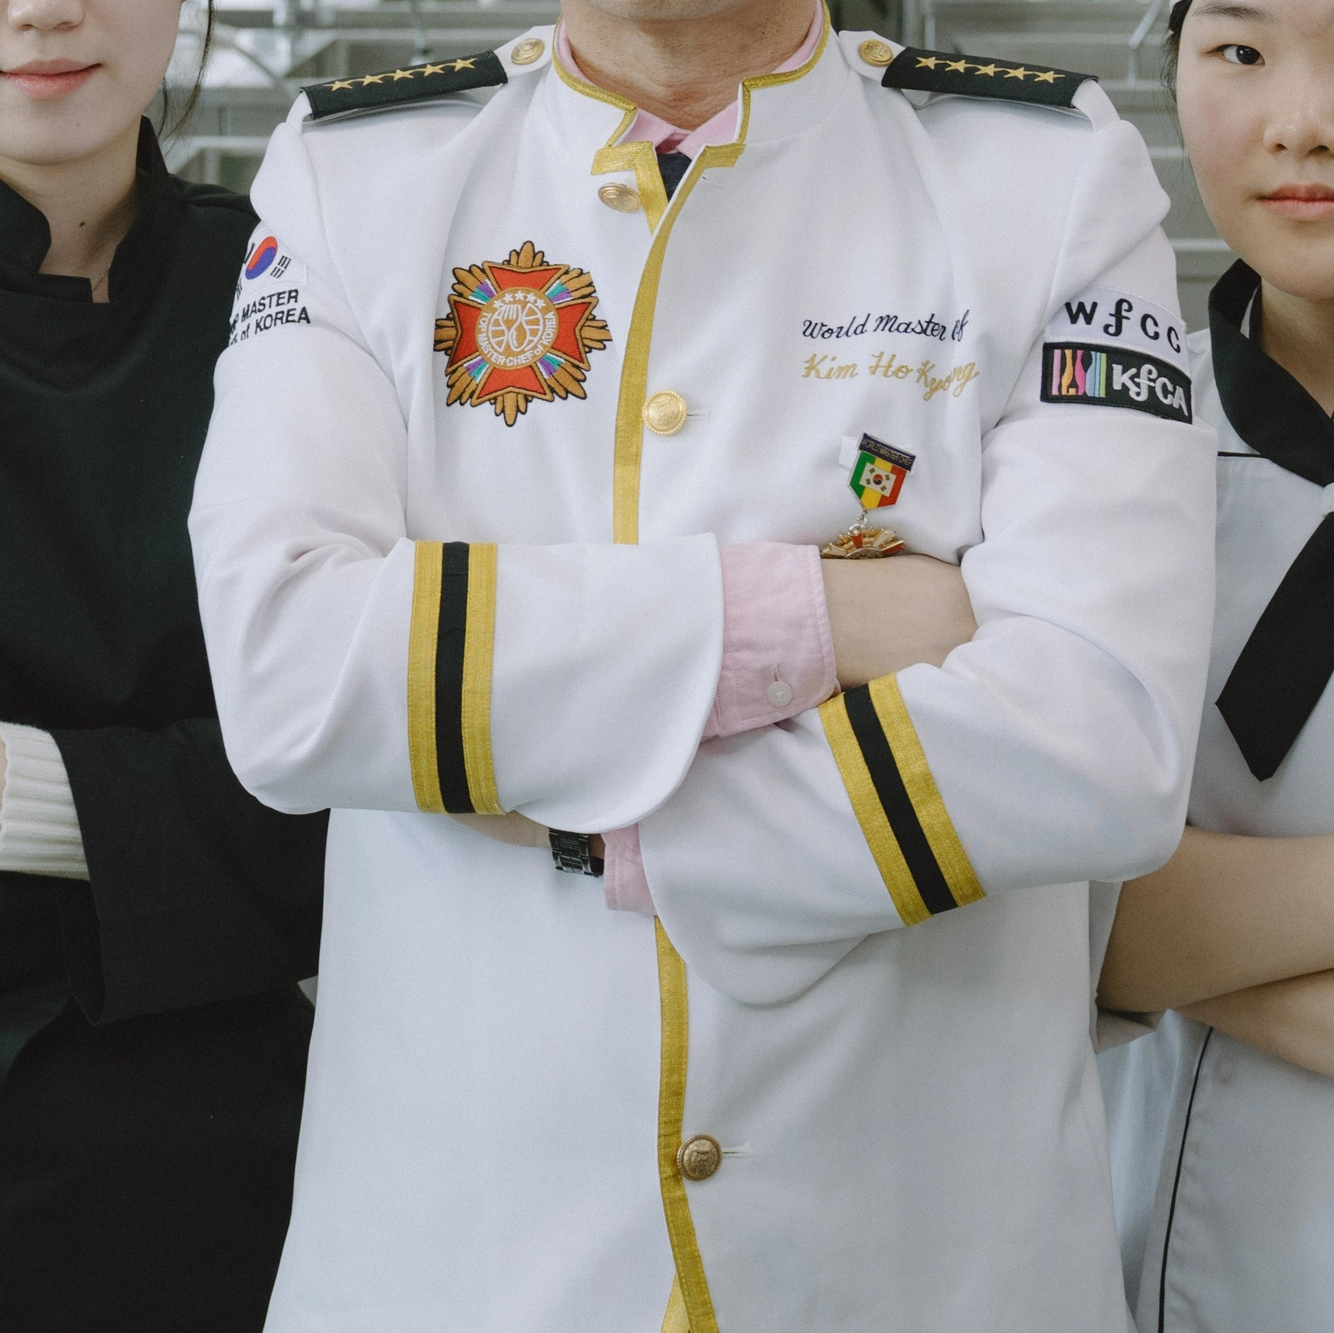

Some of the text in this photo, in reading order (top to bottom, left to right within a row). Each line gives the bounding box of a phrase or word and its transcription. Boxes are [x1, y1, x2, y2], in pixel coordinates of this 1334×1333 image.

[241, 288, 299, 323] MASTER
[254, 305, 311, 335] KOREA
[478, 312, 492, 332] TOP
[542, 311, 557, 346] KOREA
[802, 312, 871, 340] World
[873, 313, 947, 342] Master
[477, 333, 505, 366] MASTER
[506, 350, 534, 366] CHEF
[802, 353, 858, 379] Kim
[869, 351, 914, 380] Ho
